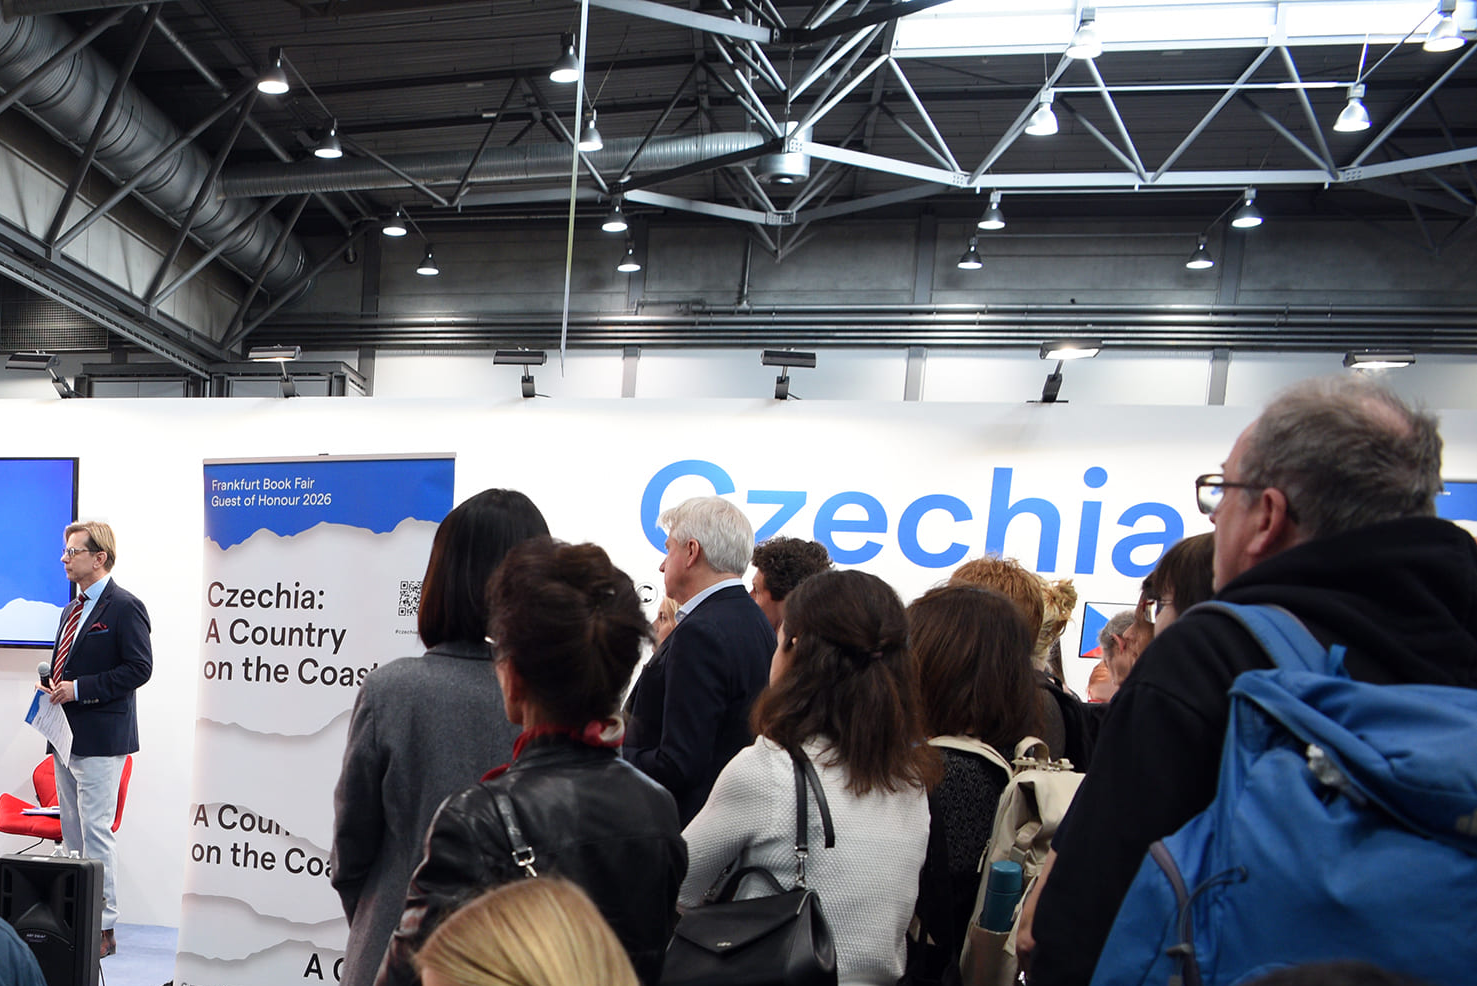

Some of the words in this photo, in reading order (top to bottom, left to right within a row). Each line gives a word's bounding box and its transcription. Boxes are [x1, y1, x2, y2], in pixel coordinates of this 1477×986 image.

[212, 479, 260, 491] Frankfurt
[263, 478, 291, 490] Book
[294, 477, 315, 489] Fair
[211, 495, 241, 507] Guest
[244, 494, 256, 506] of
[258, 494, 300, 506] Honour
[303, 493, 332, 505] 2026
[640, 460, 1184, 578] Czechia
[207, 581, 325, 610] Czechia:
[205, 617, 221, 643] A
[229, 618, 347, 655] Country
[204, 660, 233, 681] on
[242, 656, 289, 683] the
[193, 803, 209, 828] A
[191, 843, 221, 864] on
[230, 842, 276, 871] the
[303, 953, 324, 981] A
